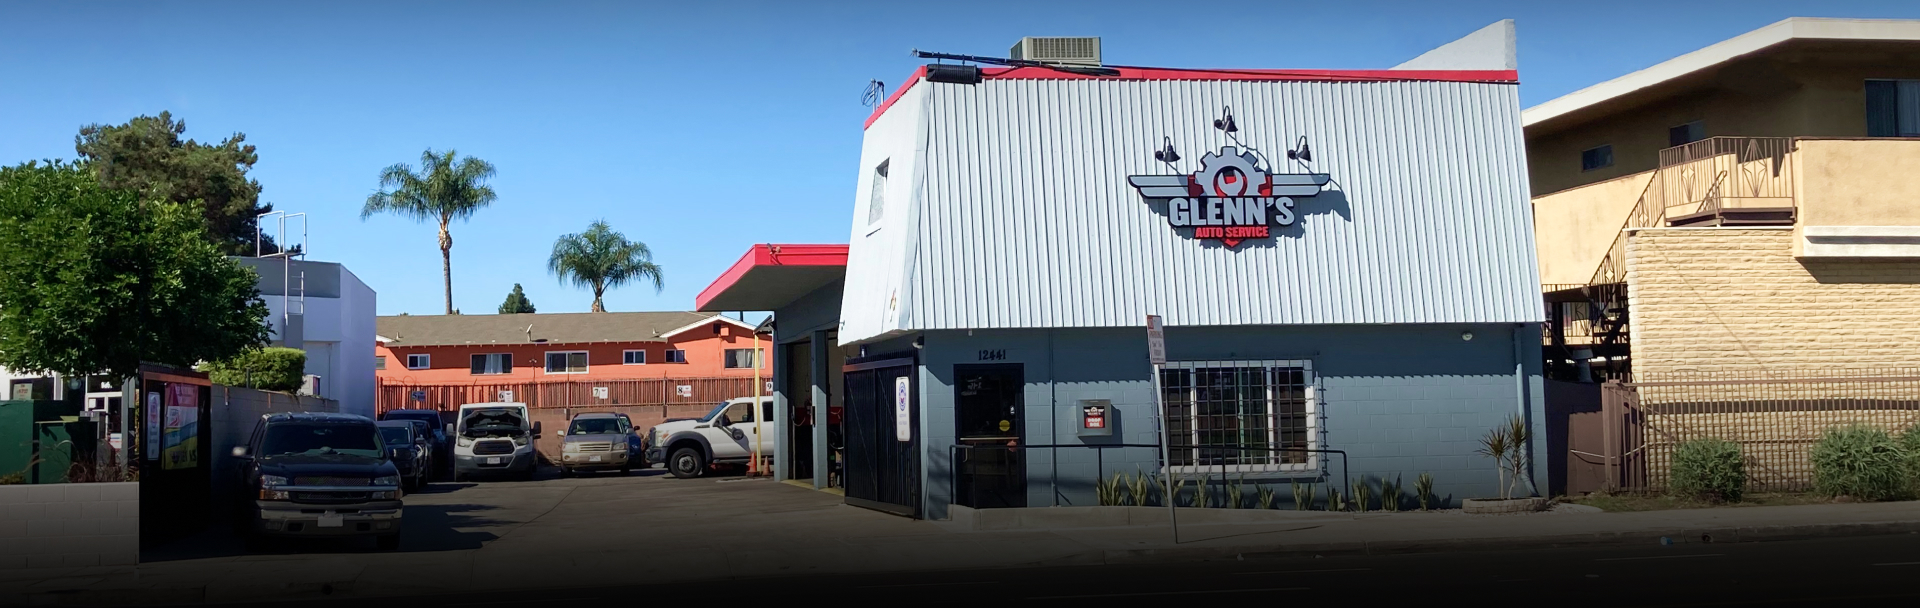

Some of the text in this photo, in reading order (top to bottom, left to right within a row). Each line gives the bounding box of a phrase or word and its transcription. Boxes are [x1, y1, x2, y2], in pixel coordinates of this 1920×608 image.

[1168, 196, 1295, 226] GLENN'S
[1195, 226, 1269, 238] AUTO SERVICE
[978, 349, 1006, 360] 12441
